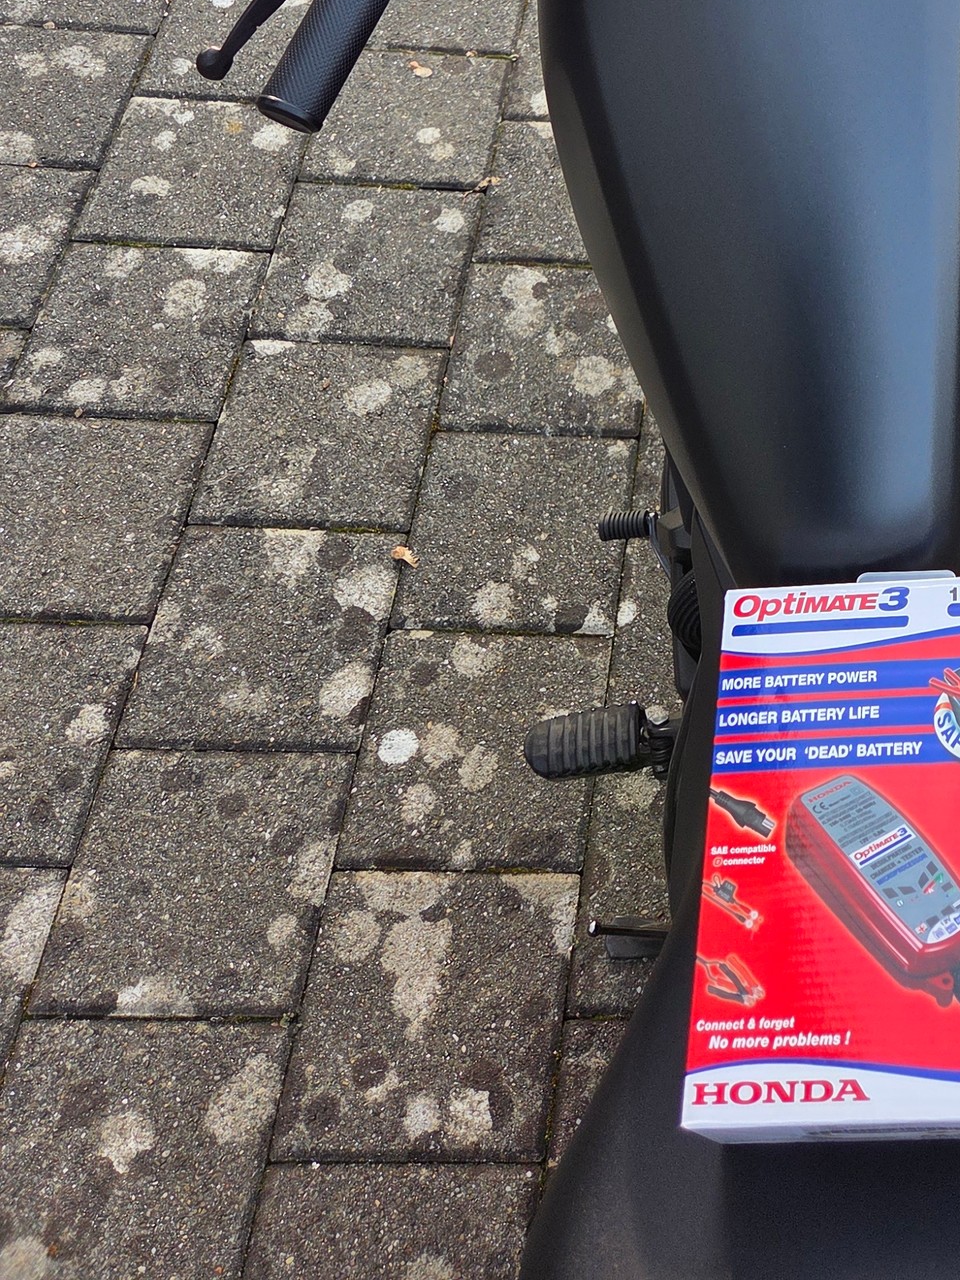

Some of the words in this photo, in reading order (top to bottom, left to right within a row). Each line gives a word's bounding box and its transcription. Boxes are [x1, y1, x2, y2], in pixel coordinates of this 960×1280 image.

[722, 675, 761, 691] MORE
[765, 673, 825, 688] BATTERY
[828, 670, 877, 684] POWER
[720, 711, 777, 727] LONGER
[781, 708, 845, 724] BATTERY
[849, 706, 880, 719] LIFE
[716, 749, 752, 764] SAVE
[756, 747, 796, 762] YOUR
[857, 742, 922, 757] BATTERY
[711, 846, 728, 855] SAE
[730, 843, 776, 855] compatible
[723, 856, 765, 865] connector
[696, 1018, 744, 1031] Connect
[748, 1018, 757, 1029] &
[759, 1017, 795, 1030] forget
[709, 1035, 728, 1049] No
[731, 1037, 770, 1048] more
[773, 1033, 841, 1050] problems
[691, 1078, 870, 1106] HONDA
